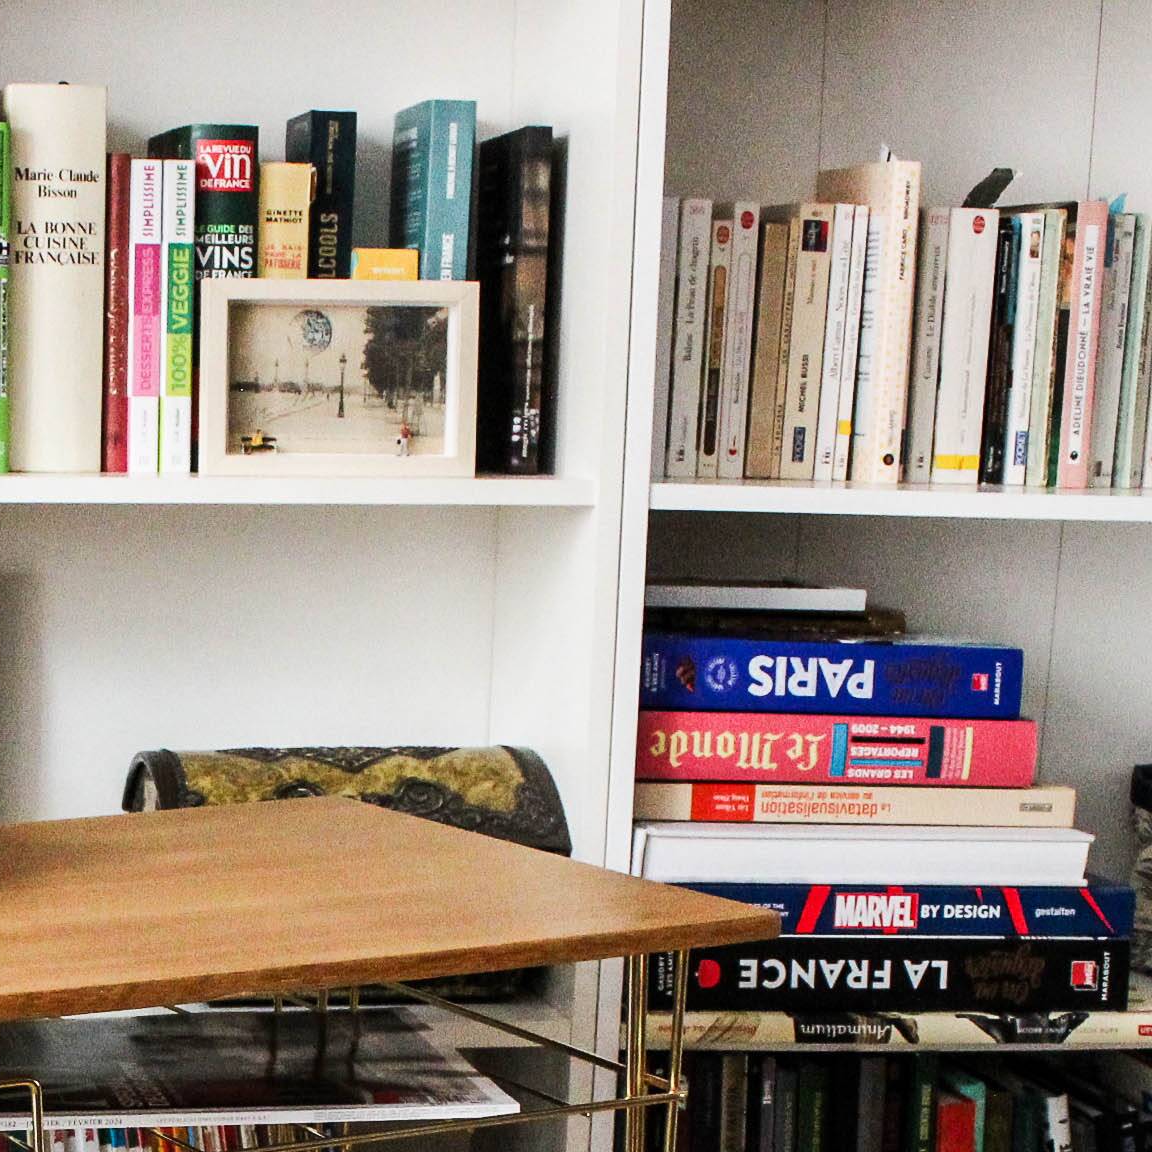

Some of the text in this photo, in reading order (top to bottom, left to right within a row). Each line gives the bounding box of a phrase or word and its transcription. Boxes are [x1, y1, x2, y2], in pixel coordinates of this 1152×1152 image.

[200, 144, 250, 154] LA REVUE DU
[14, 167, 99, 183] Marie Claude
[38, 185, 77, 198] Bisson
[200, 179, 250, 189] DE FRANCE
[143, 165, 155, 237] SIMPLISSIME
[175, 165, 187, 237] SIMPLISSIME
[16, 221, 97, 235] LA BONNE
[207, 225, 235, 233] GUIDE
[238, 225, 253, 233] DES
[23, 236, 88, 249] CUISINE
[196, 234, 254, 244] MEILLEURS
[14, 250, 100, 266] FRANÇAISE
[196, 245, 253, 269] VINS
[211, 270, 253, 279] FRANCE
[171, 247, 189, 391] 100% VEGGIE
[1072, 245, 1095, 436] ADELINE DIEUDONNÉ LA VRAIE VIE
[797, 353, 809, 413] MICHEL BUSSI
[748, 653, 875, 700] PARIS
[993, 662, 1003, 706] MARABOUT
[852, 724, 916, 733] 1944 2009
[650, 728, 827, 771] Le Monde
[850, 747, 919, 757] REPORTAGES
[848, 769, 914, 778] LES GRANDS
[761, 791, 815, 800] l'information
[761, 801, 878, 818] datavisualisation
[834, 894, 1001, 929] MARVEL BY DESIGN
[1035, 905, 1076, 919] gestalten
[738, 959, 948, 990] LA FRANCE
[1101, 951, 1111, 1001] MARABOUT
[799, 1024, 891, 1040] Animalium
